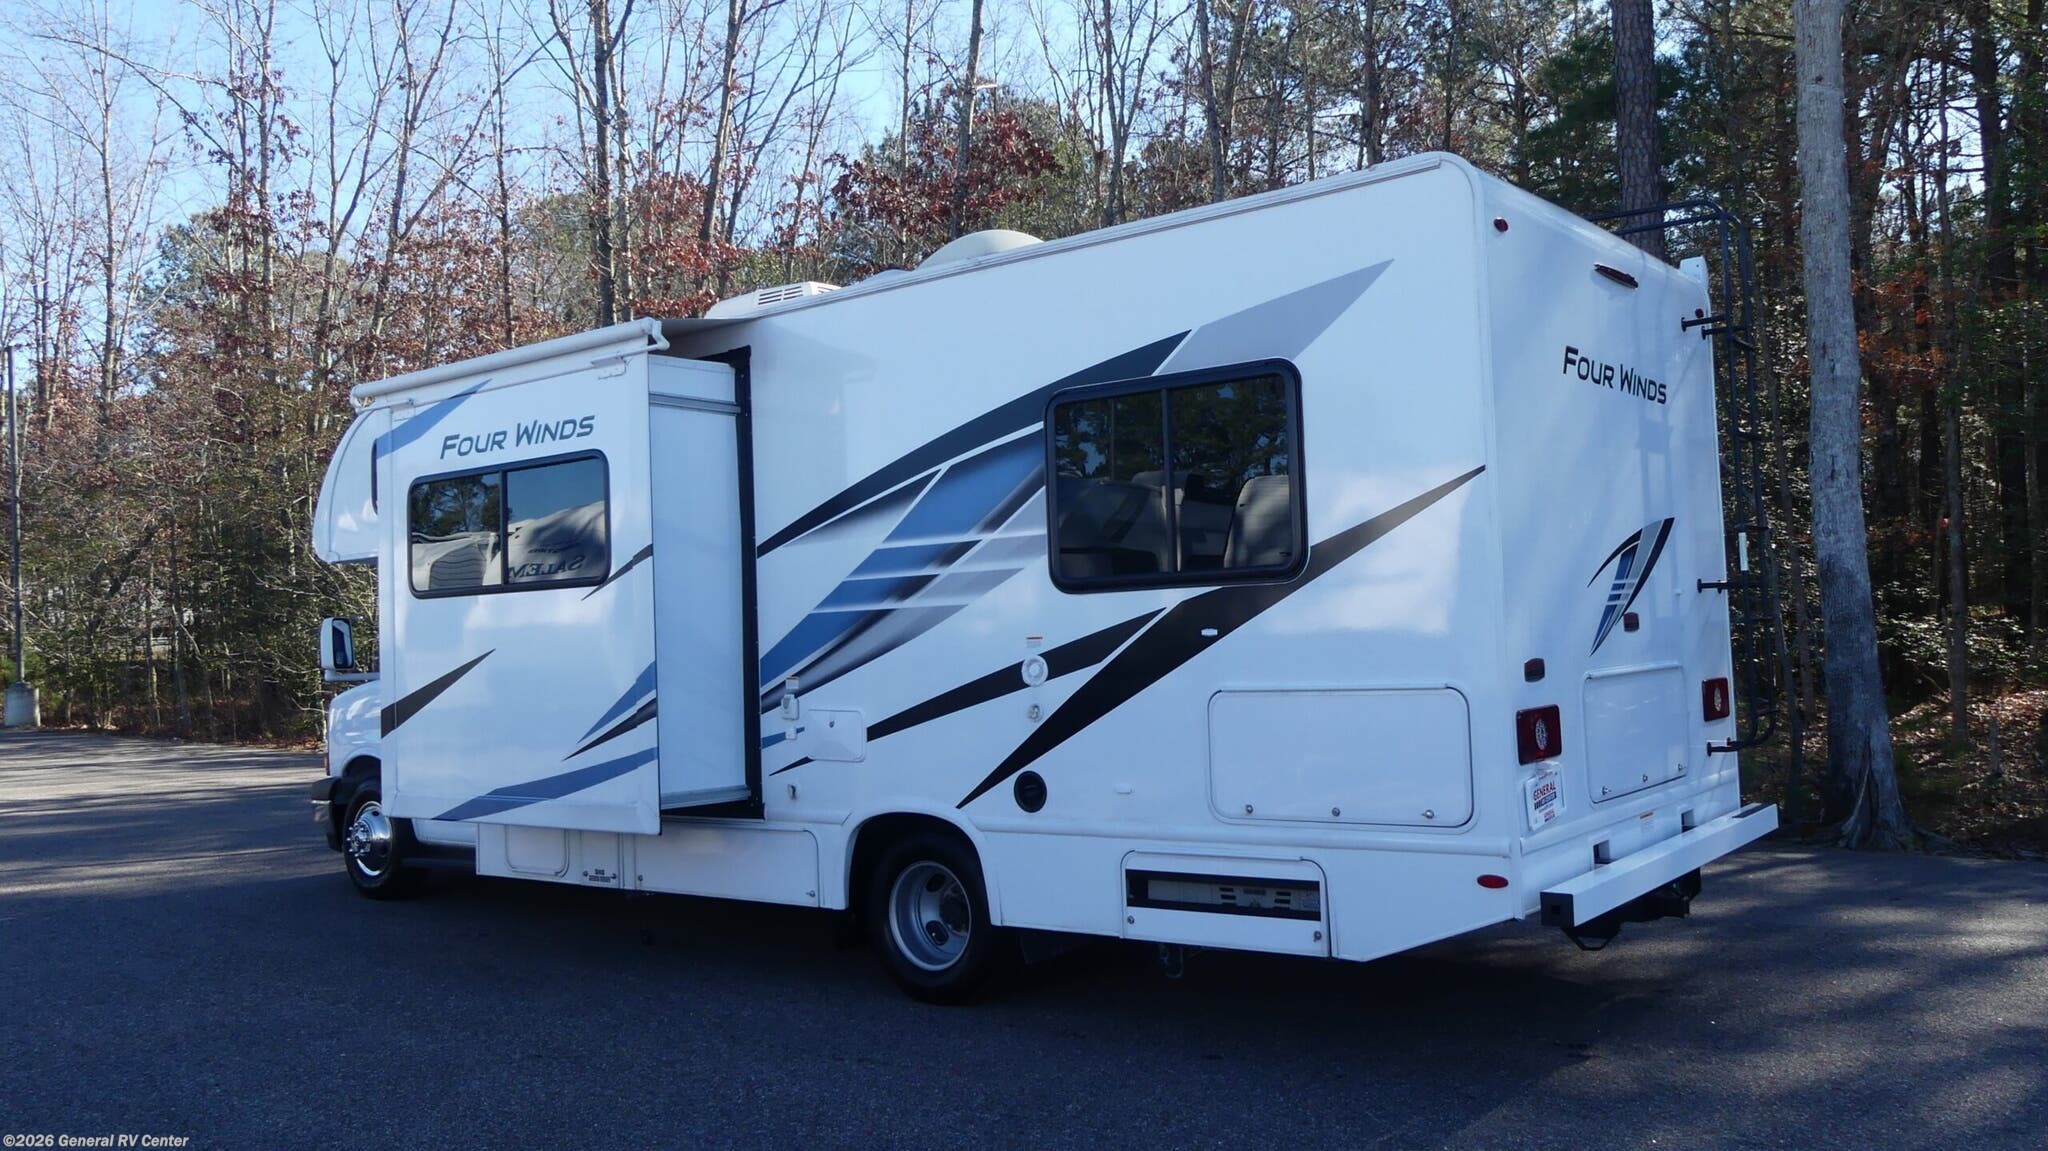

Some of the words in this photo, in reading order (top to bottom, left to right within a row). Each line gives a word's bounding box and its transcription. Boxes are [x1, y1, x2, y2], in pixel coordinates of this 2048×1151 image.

[1563, 346, 1615, 388] FOUR
[1620, 364, 1667, 404] WINDS
[440, 431, 508, 460] FOUR
[516, 415, 596, 447] WINDS
[1533, 781, 1556, 801] GENERAL
